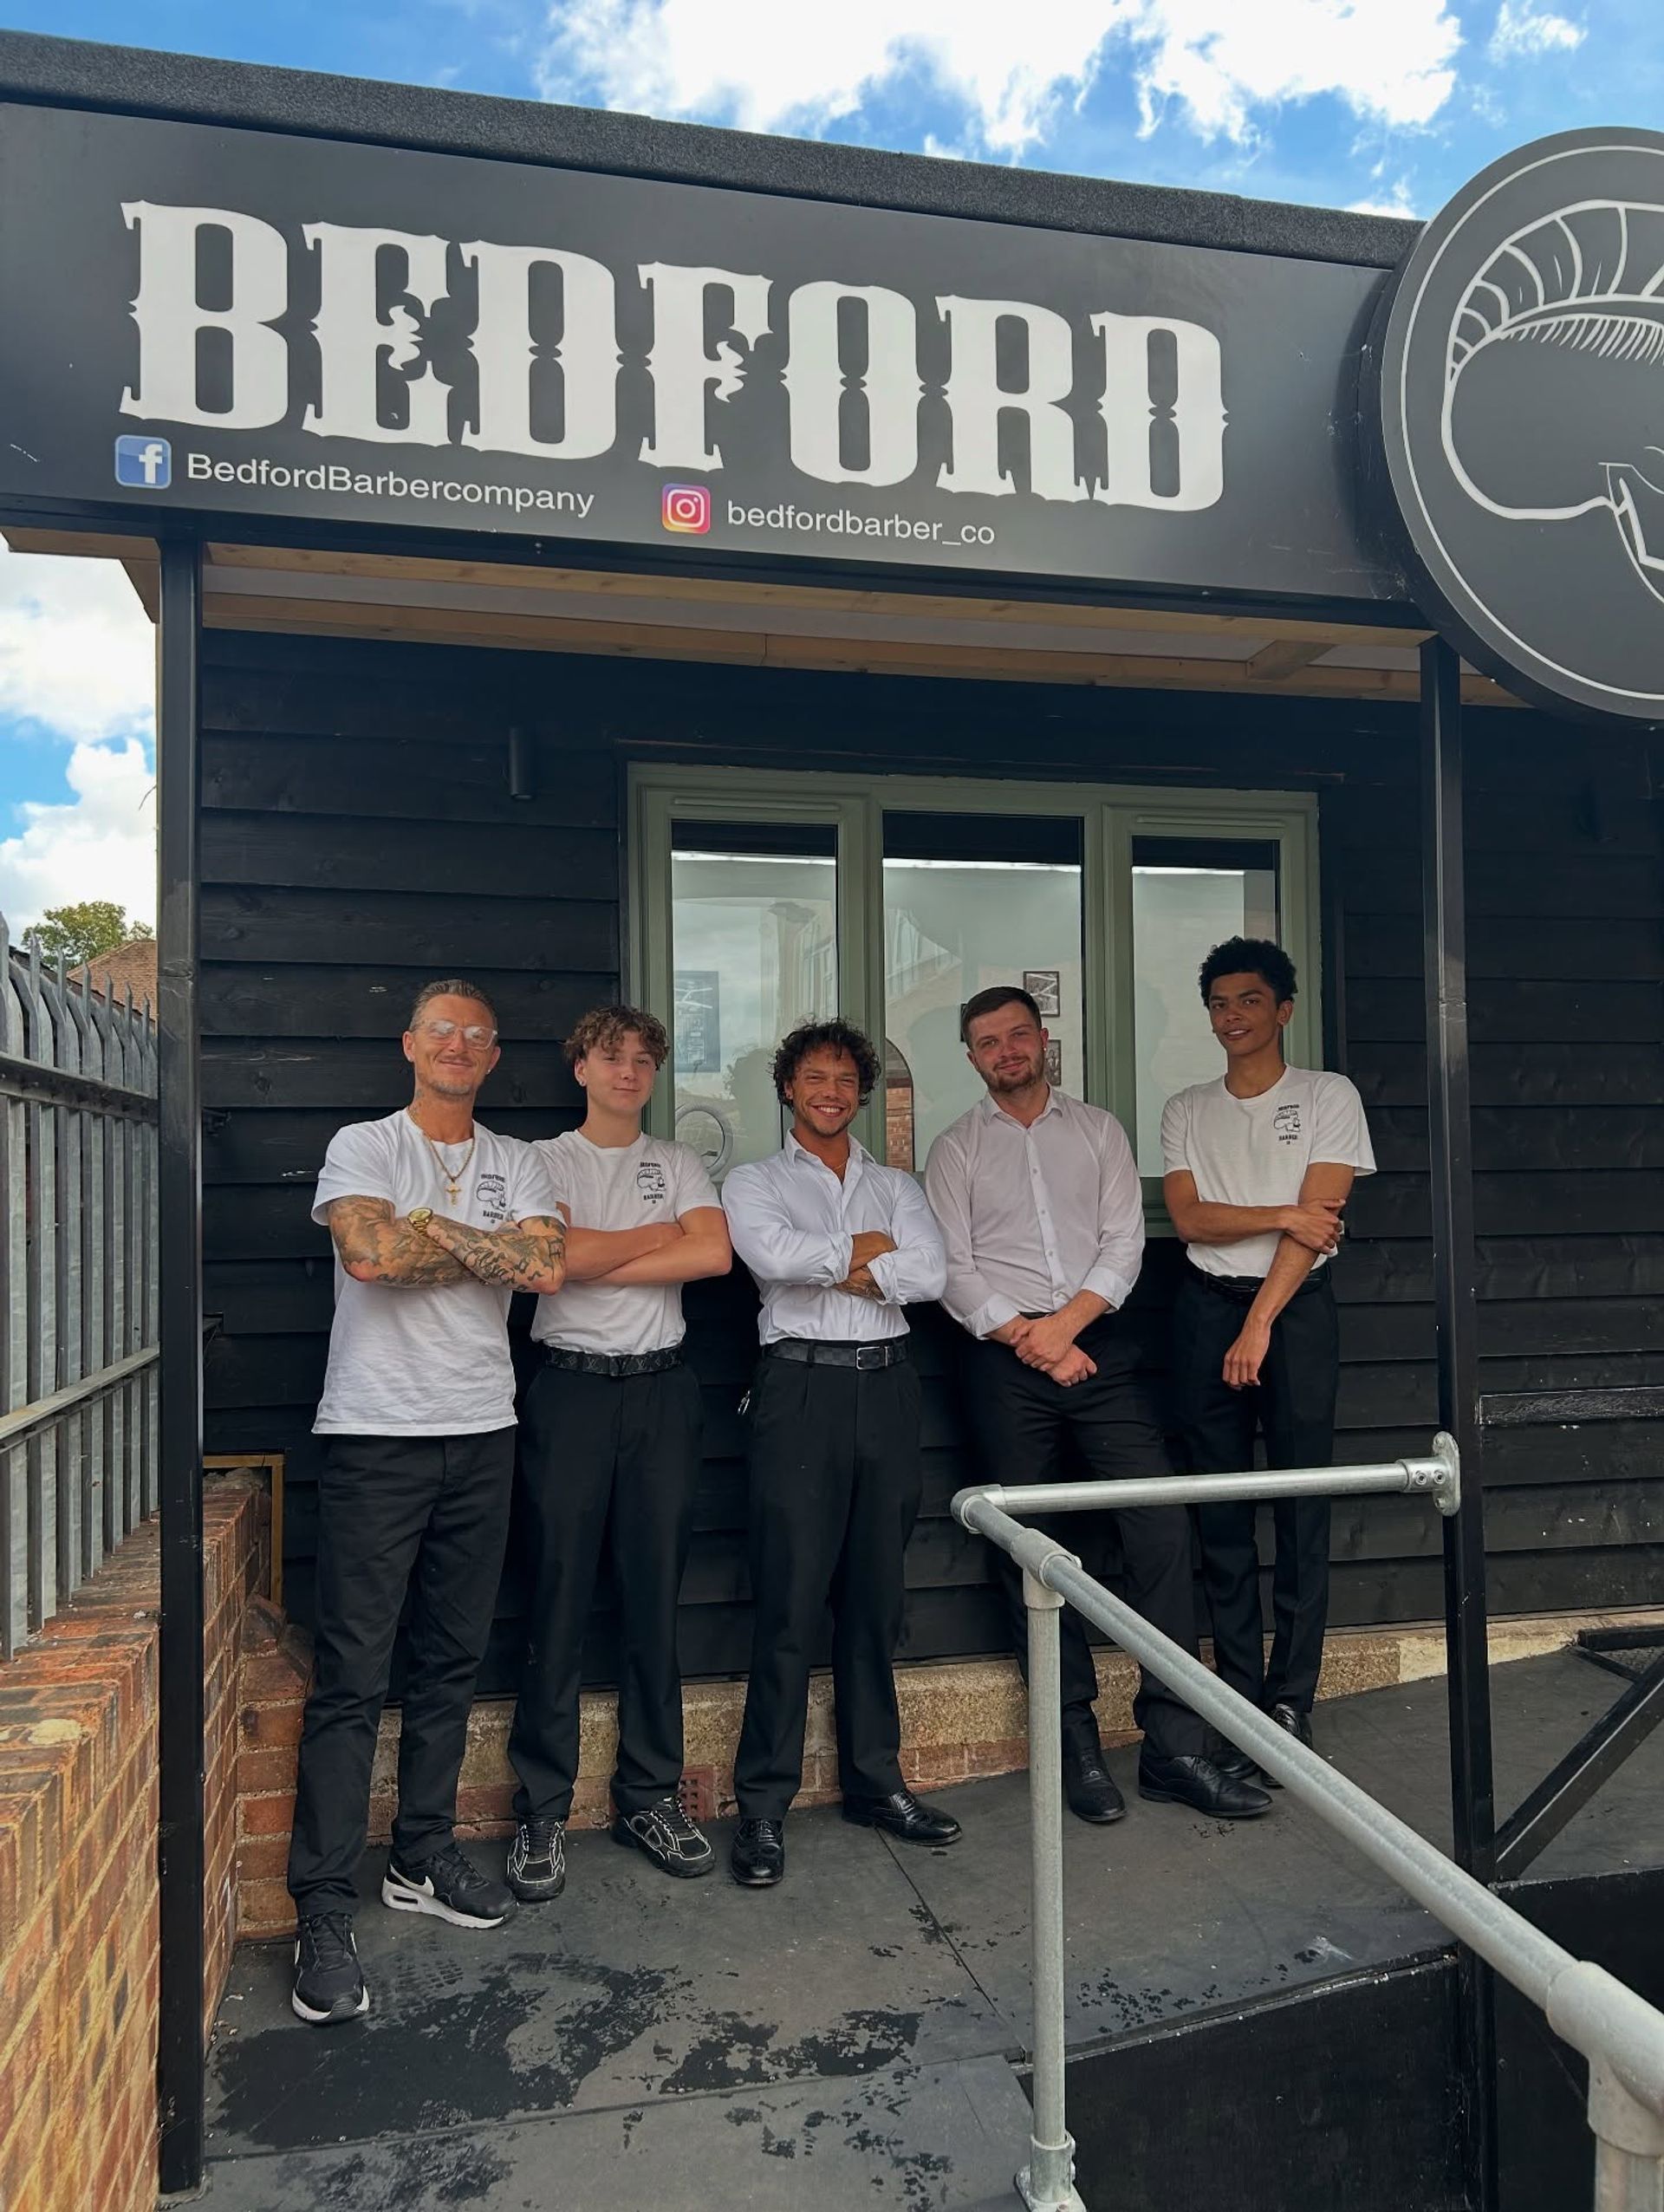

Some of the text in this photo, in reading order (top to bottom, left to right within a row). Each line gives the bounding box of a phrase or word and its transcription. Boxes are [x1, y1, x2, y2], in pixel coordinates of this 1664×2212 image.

[120, 200, 1230, 513] BEDFORD
[187, 452, 595, 518] BedfordBarbercompany
[727, 499, 996, 546] bedfordbarber_co
